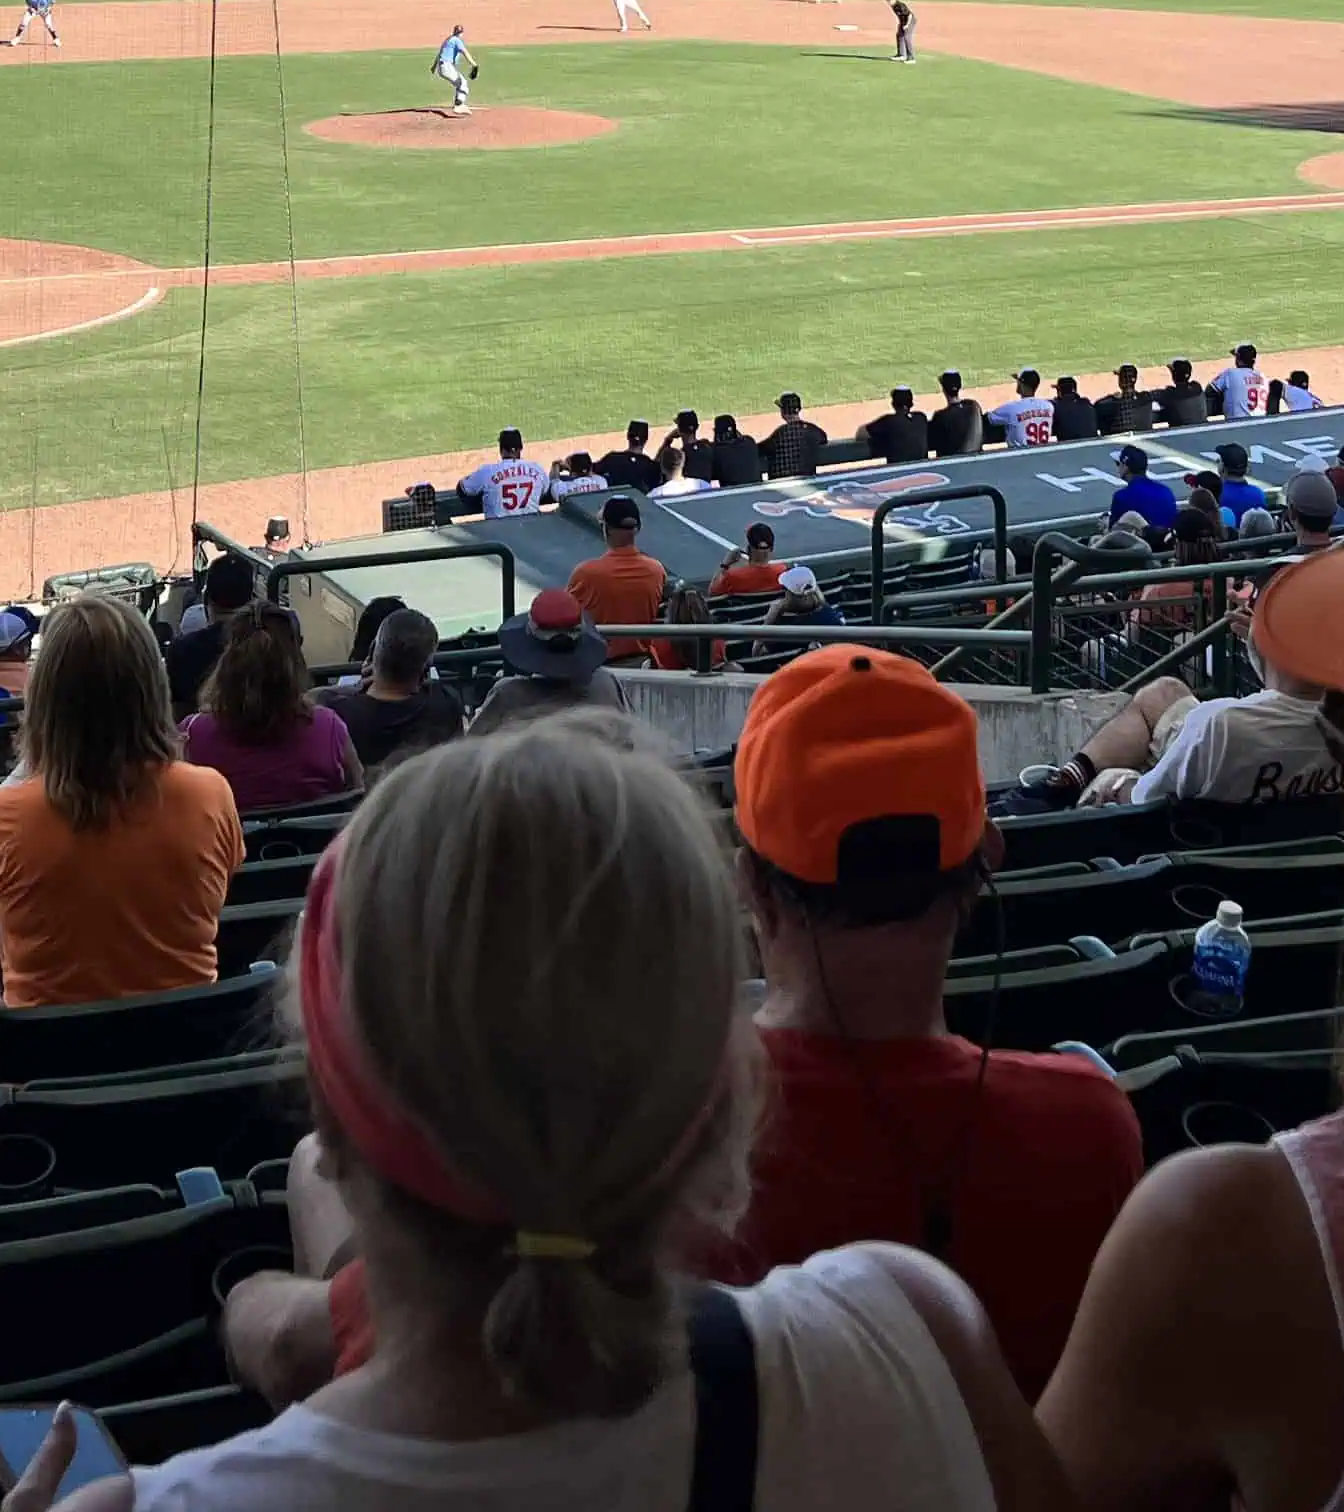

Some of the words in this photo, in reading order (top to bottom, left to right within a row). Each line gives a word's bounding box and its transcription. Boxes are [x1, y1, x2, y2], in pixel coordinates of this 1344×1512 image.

[1025, 421, 1049, 446] 96
[490, 464, 541, 485] GONZALEZ
[501, 481, 534, 511] 57
